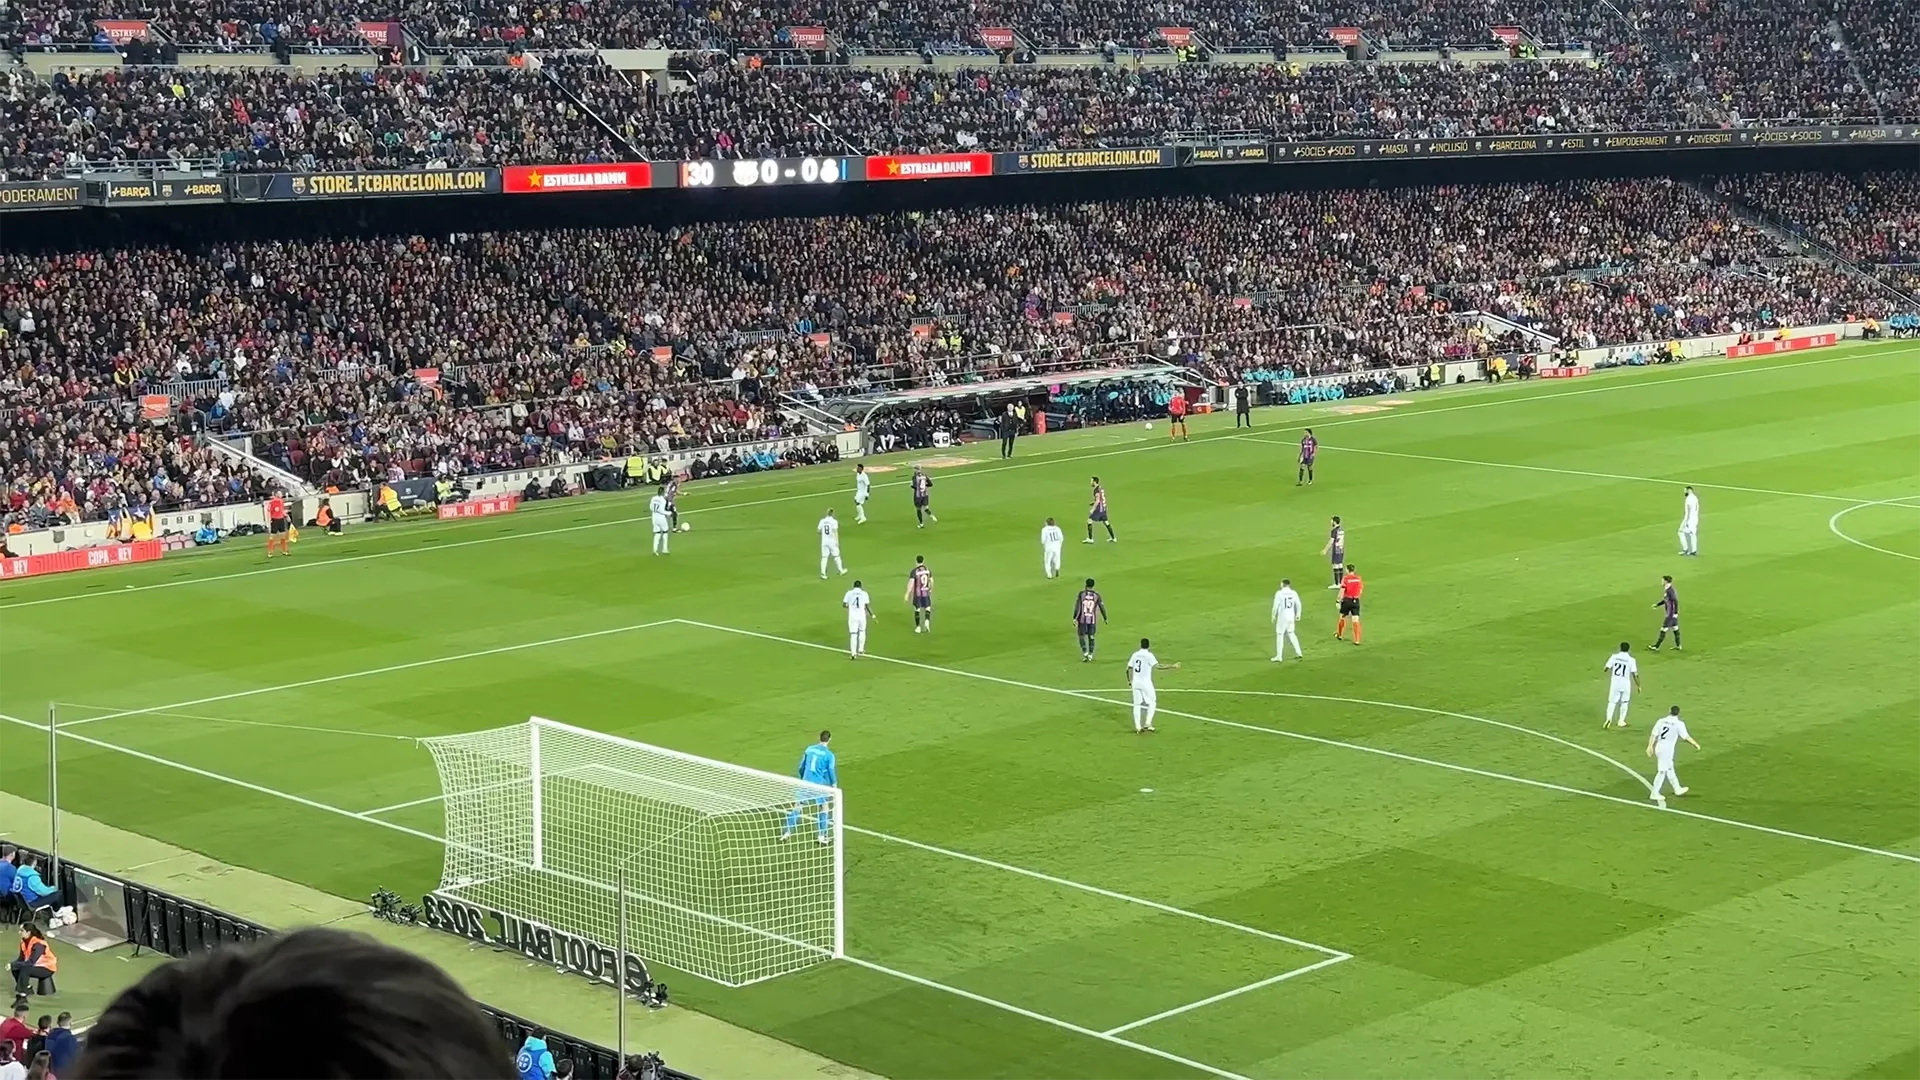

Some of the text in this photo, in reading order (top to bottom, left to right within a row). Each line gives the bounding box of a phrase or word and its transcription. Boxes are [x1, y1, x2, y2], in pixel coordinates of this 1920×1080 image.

[1031, 150, 1161, 168] STORE.FCBARCELONA.COM
[688, 161, 714, 186] 30
[760, 159, 779, 184] 0
[801, 158, 818, 183] 0
[901, 161, 971, 175] ESTRELLA DAMM
[310, 171, 486, 194] STORE.FCBARCELONA.COM
[543, 171, 627, 187] ESTRELLA DAMM
[88, 547, 133, 566] COPA REY
[13, 560, 28, 574] REY
[920, 574, 929, 588] 9
[852, 597, 860, 608] 4
[1284, 597, 1293, 609] 15
[1134, 659, 1142, 673] 3
[1614, 662, 1627, 677] 21
[1660, 726, 1670, 739] 2
